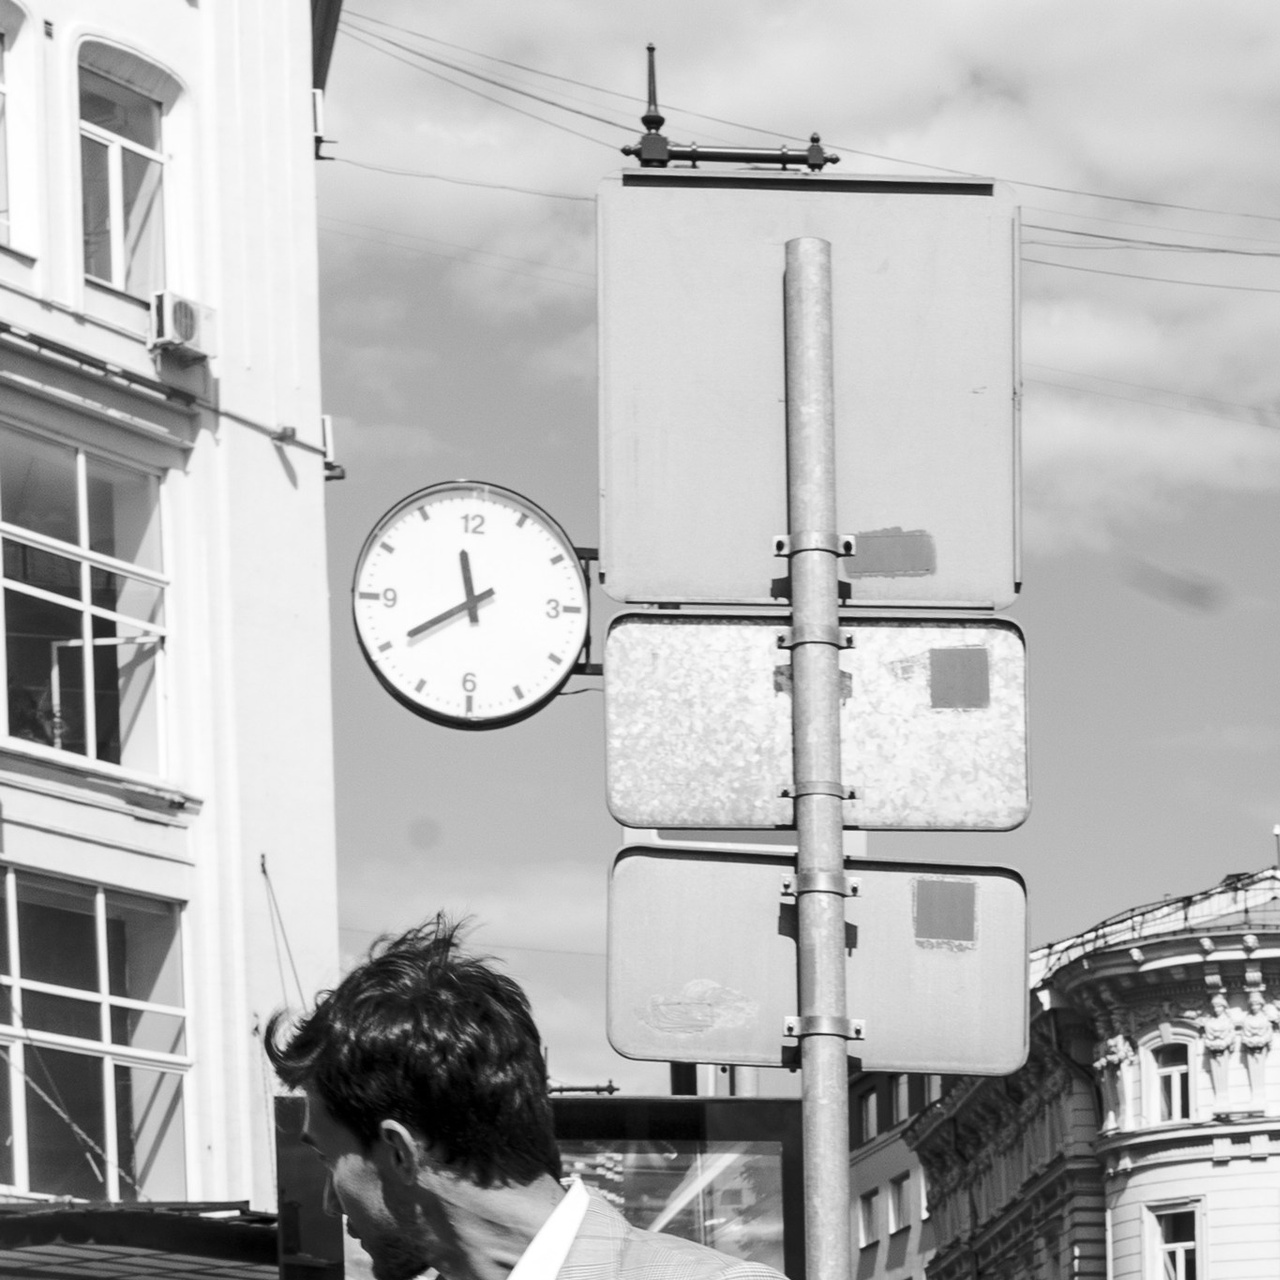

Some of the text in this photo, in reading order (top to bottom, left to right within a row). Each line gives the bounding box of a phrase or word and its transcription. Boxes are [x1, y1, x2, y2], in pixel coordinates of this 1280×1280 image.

[460, 513, 485, 534] 12
[382, 588, 397, 607] 9
[545, 599, 560, 618] 3
[461, 673, 477, 692] 6
